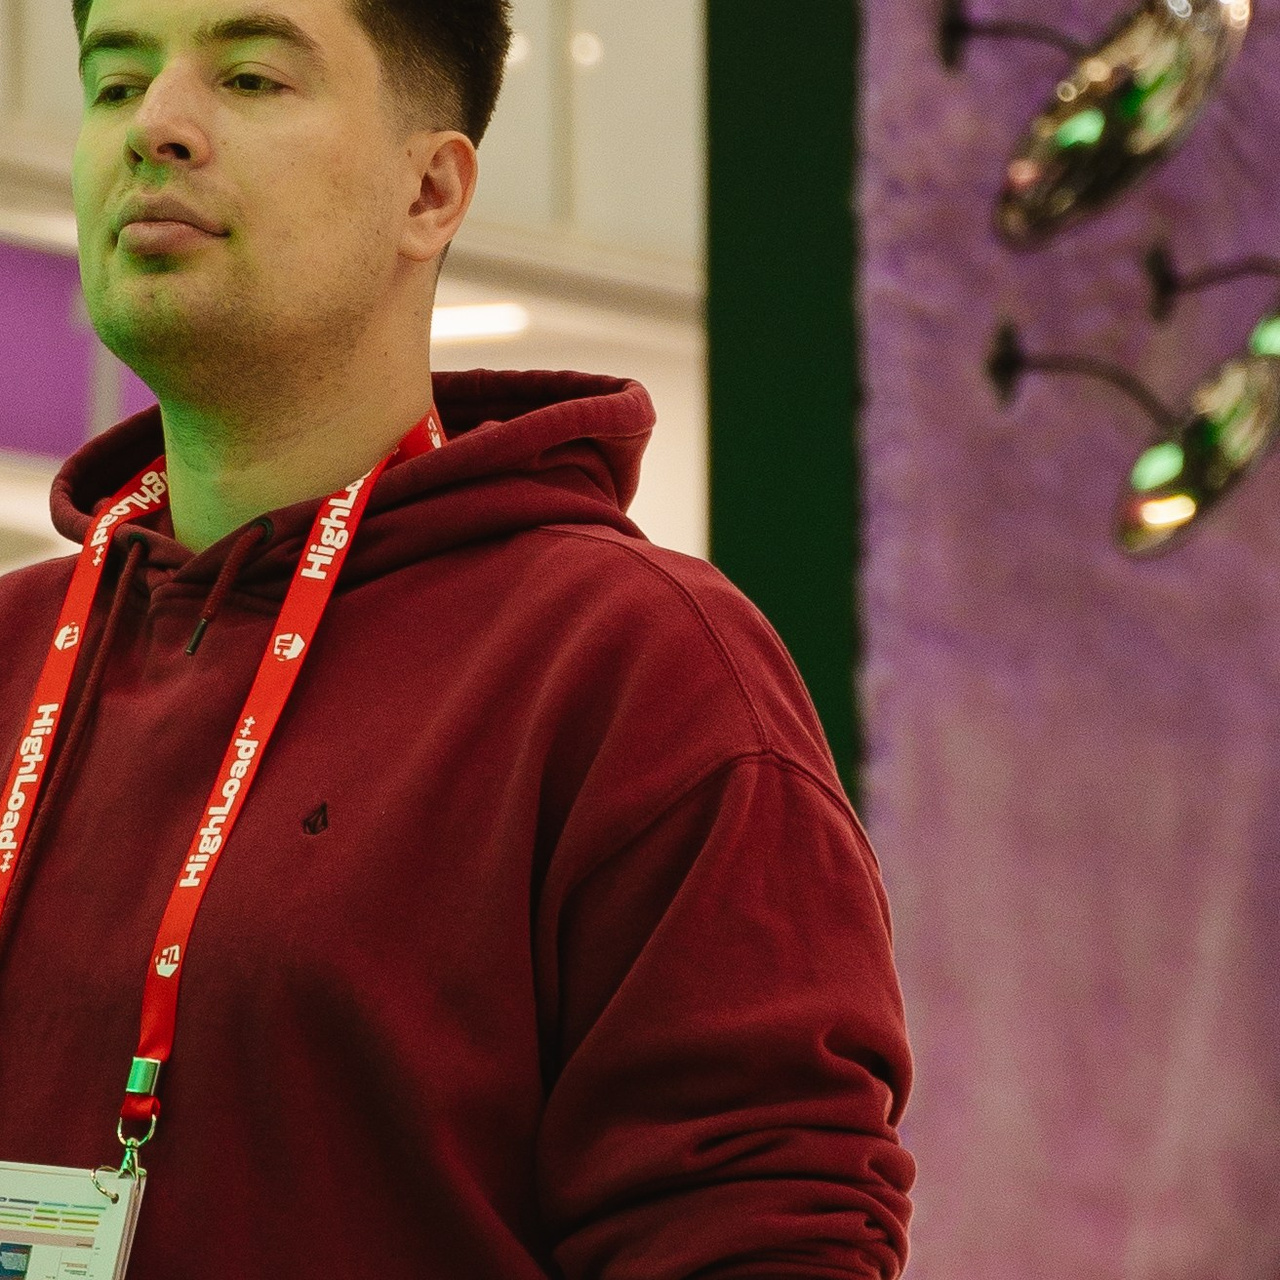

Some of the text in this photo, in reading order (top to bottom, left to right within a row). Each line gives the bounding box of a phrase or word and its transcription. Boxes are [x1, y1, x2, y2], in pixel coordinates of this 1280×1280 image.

[90, 471, 168, 567] ghLoad++
[300, 469, 372, 581] HighLo
[179, 715, 259, 888] HighLoad++
